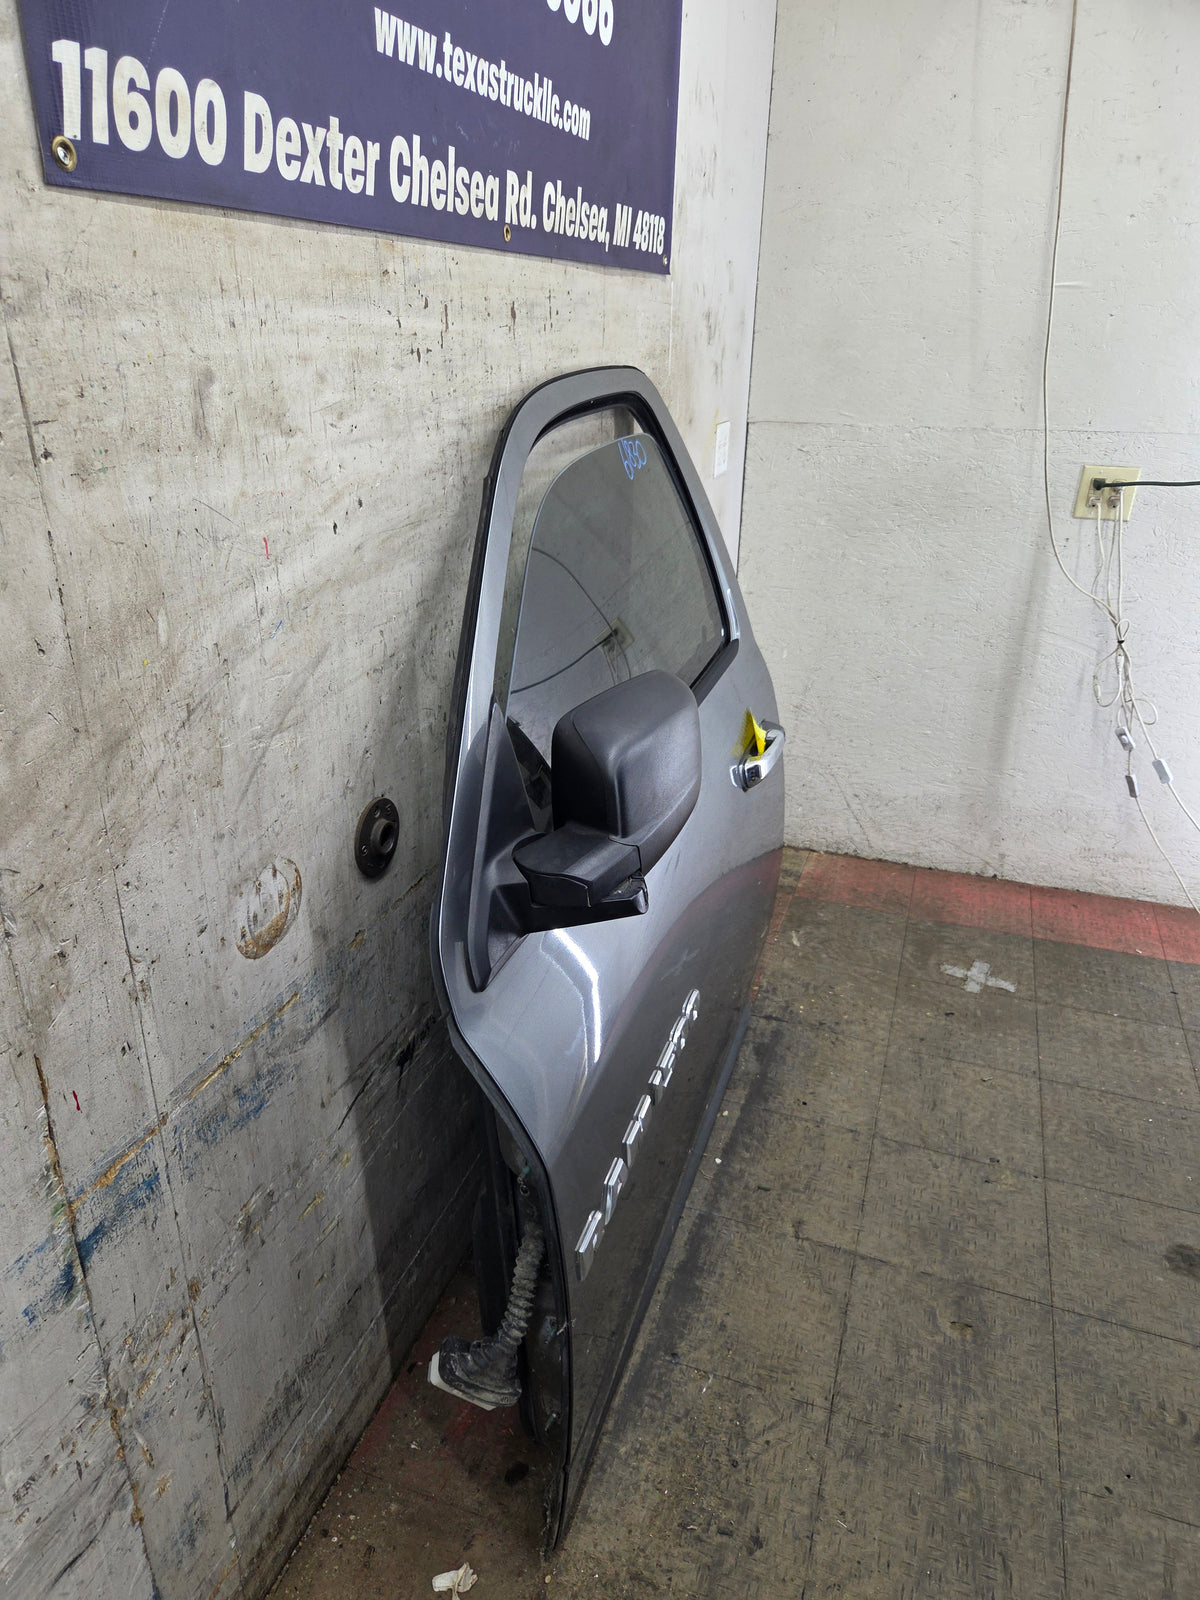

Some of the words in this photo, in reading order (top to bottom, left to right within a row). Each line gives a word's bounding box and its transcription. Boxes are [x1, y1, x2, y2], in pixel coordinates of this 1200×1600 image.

[52, 39, 227, 166] 11600
[244, 90, 380, 197] Dexter
[389, 133, 500, 223] Chelsea
[505, 169, 537, 230] Rd.
[542, 179, 610, 252] Chelsea,
[612, 202, 633, 248] MI
[632, 209, 666, 256] 48118
[374, 6, 591, 141] www.texastruckllc.com
